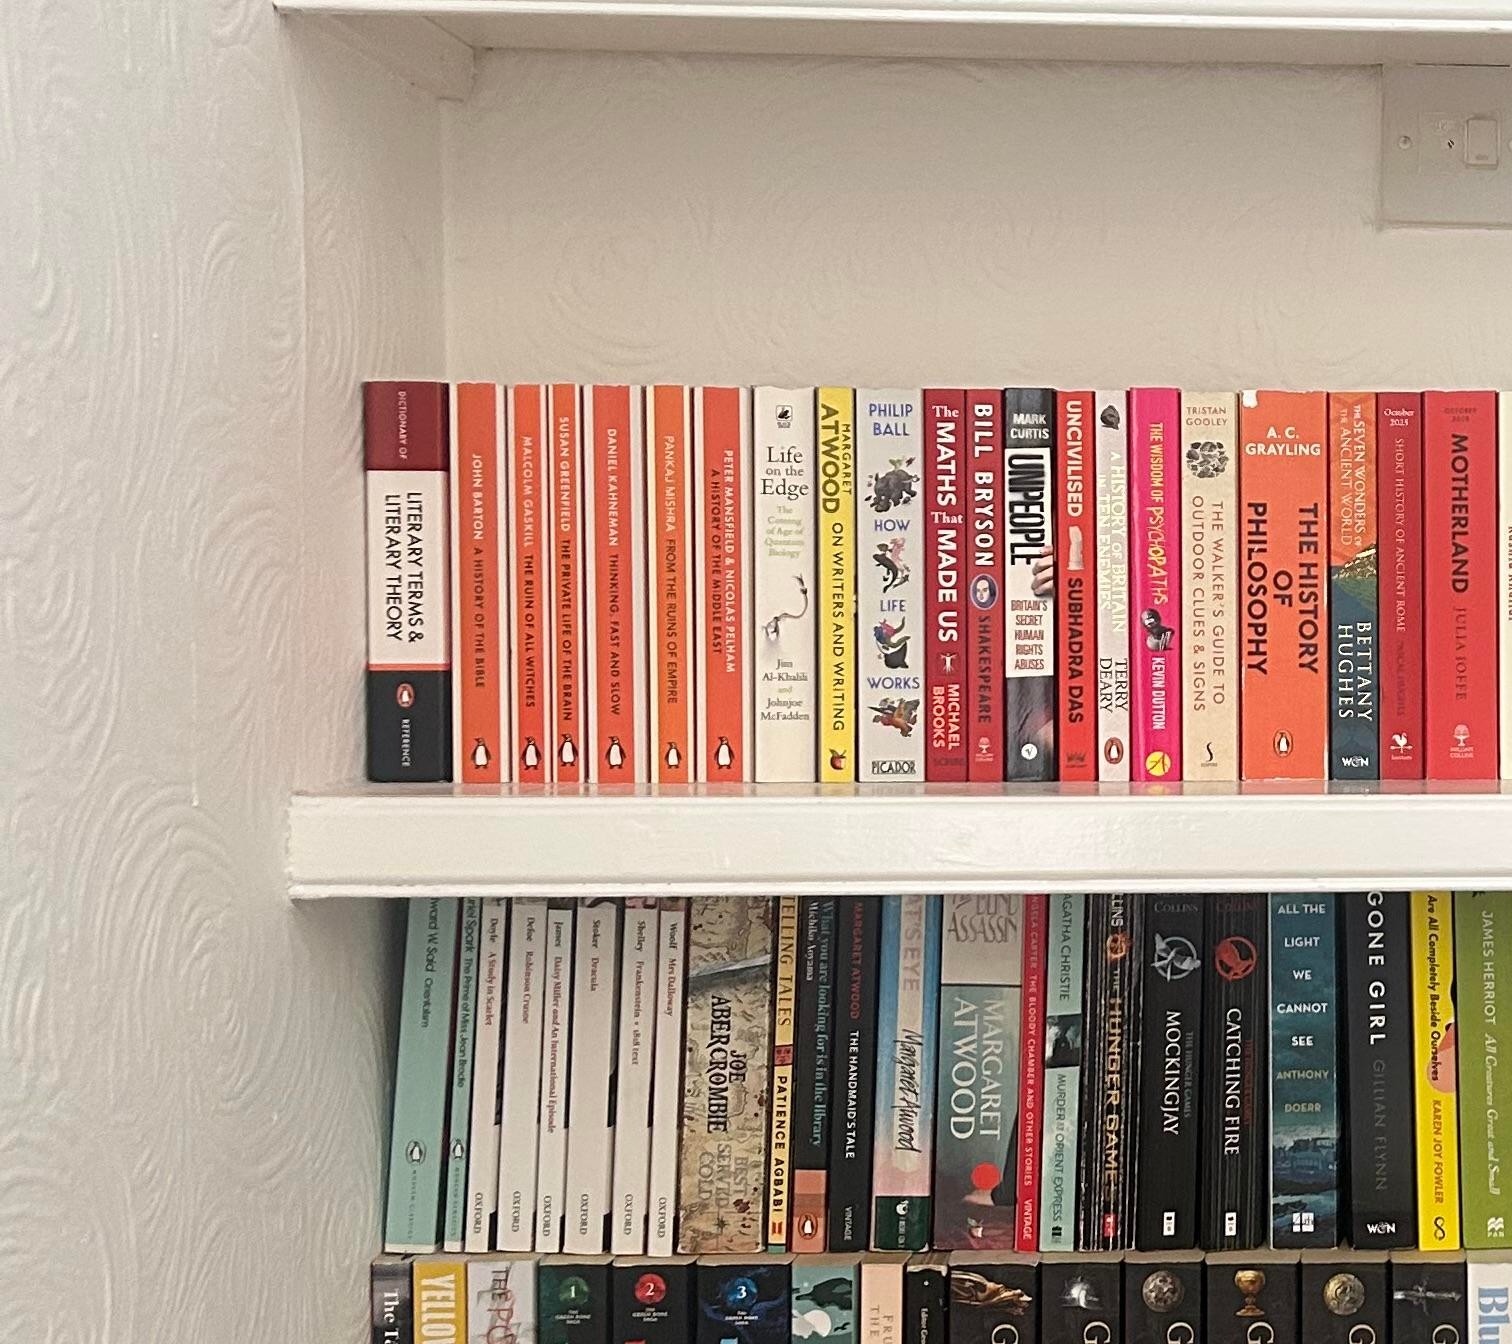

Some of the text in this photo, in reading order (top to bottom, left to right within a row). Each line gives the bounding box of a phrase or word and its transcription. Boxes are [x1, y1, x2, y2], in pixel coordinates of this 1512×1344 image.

[766, 446, 803, 465] Life
[821, 404, 840, 513] ATWOOD
[868, 404, 913, 418] PHILIP
[873, 422, 910, 436] BALL
[937, 422, 957, 506] MATHS
[1066, 400, 1083, 516] UNCIVILISED
[1246, 441, 1321, 455] GRAYLING
[472, 454, 483, 539] JOHN BARTON
[760, 478, 808, 499] Edge
[766, 466, 804, 476] on the
[974, 404, 994, 567] BILL BRYSON
[1008, 454, 1046, 565] UNPEOPLE
[1451, 434, 1469, 593] MOTHERLAND
[385, 494, 402, 640] LITERARY THEORY
[406, 492, 422, 642] LITERARY TERMS &
[938, 529, 958, 642] MADE US
[1247, 502, 1267, 675] PHILOSOPHY
[1273, 571, 1292, 607] OF
[1298, 503, 1318, 672] THE HISTORY
[831, 523, 846, 731] ON WRITERS AND WRITING
[867, 677, 920, 690] WORKS
[1283, 937, 1320, 948] LIGHT
[1368, 892, 1386, 1044] GONE GIRL
[1162, 1011, 1179, 1135] MOCKINGJAY
[1224, 1008, 1241, 1155] CATCHING FIRE
